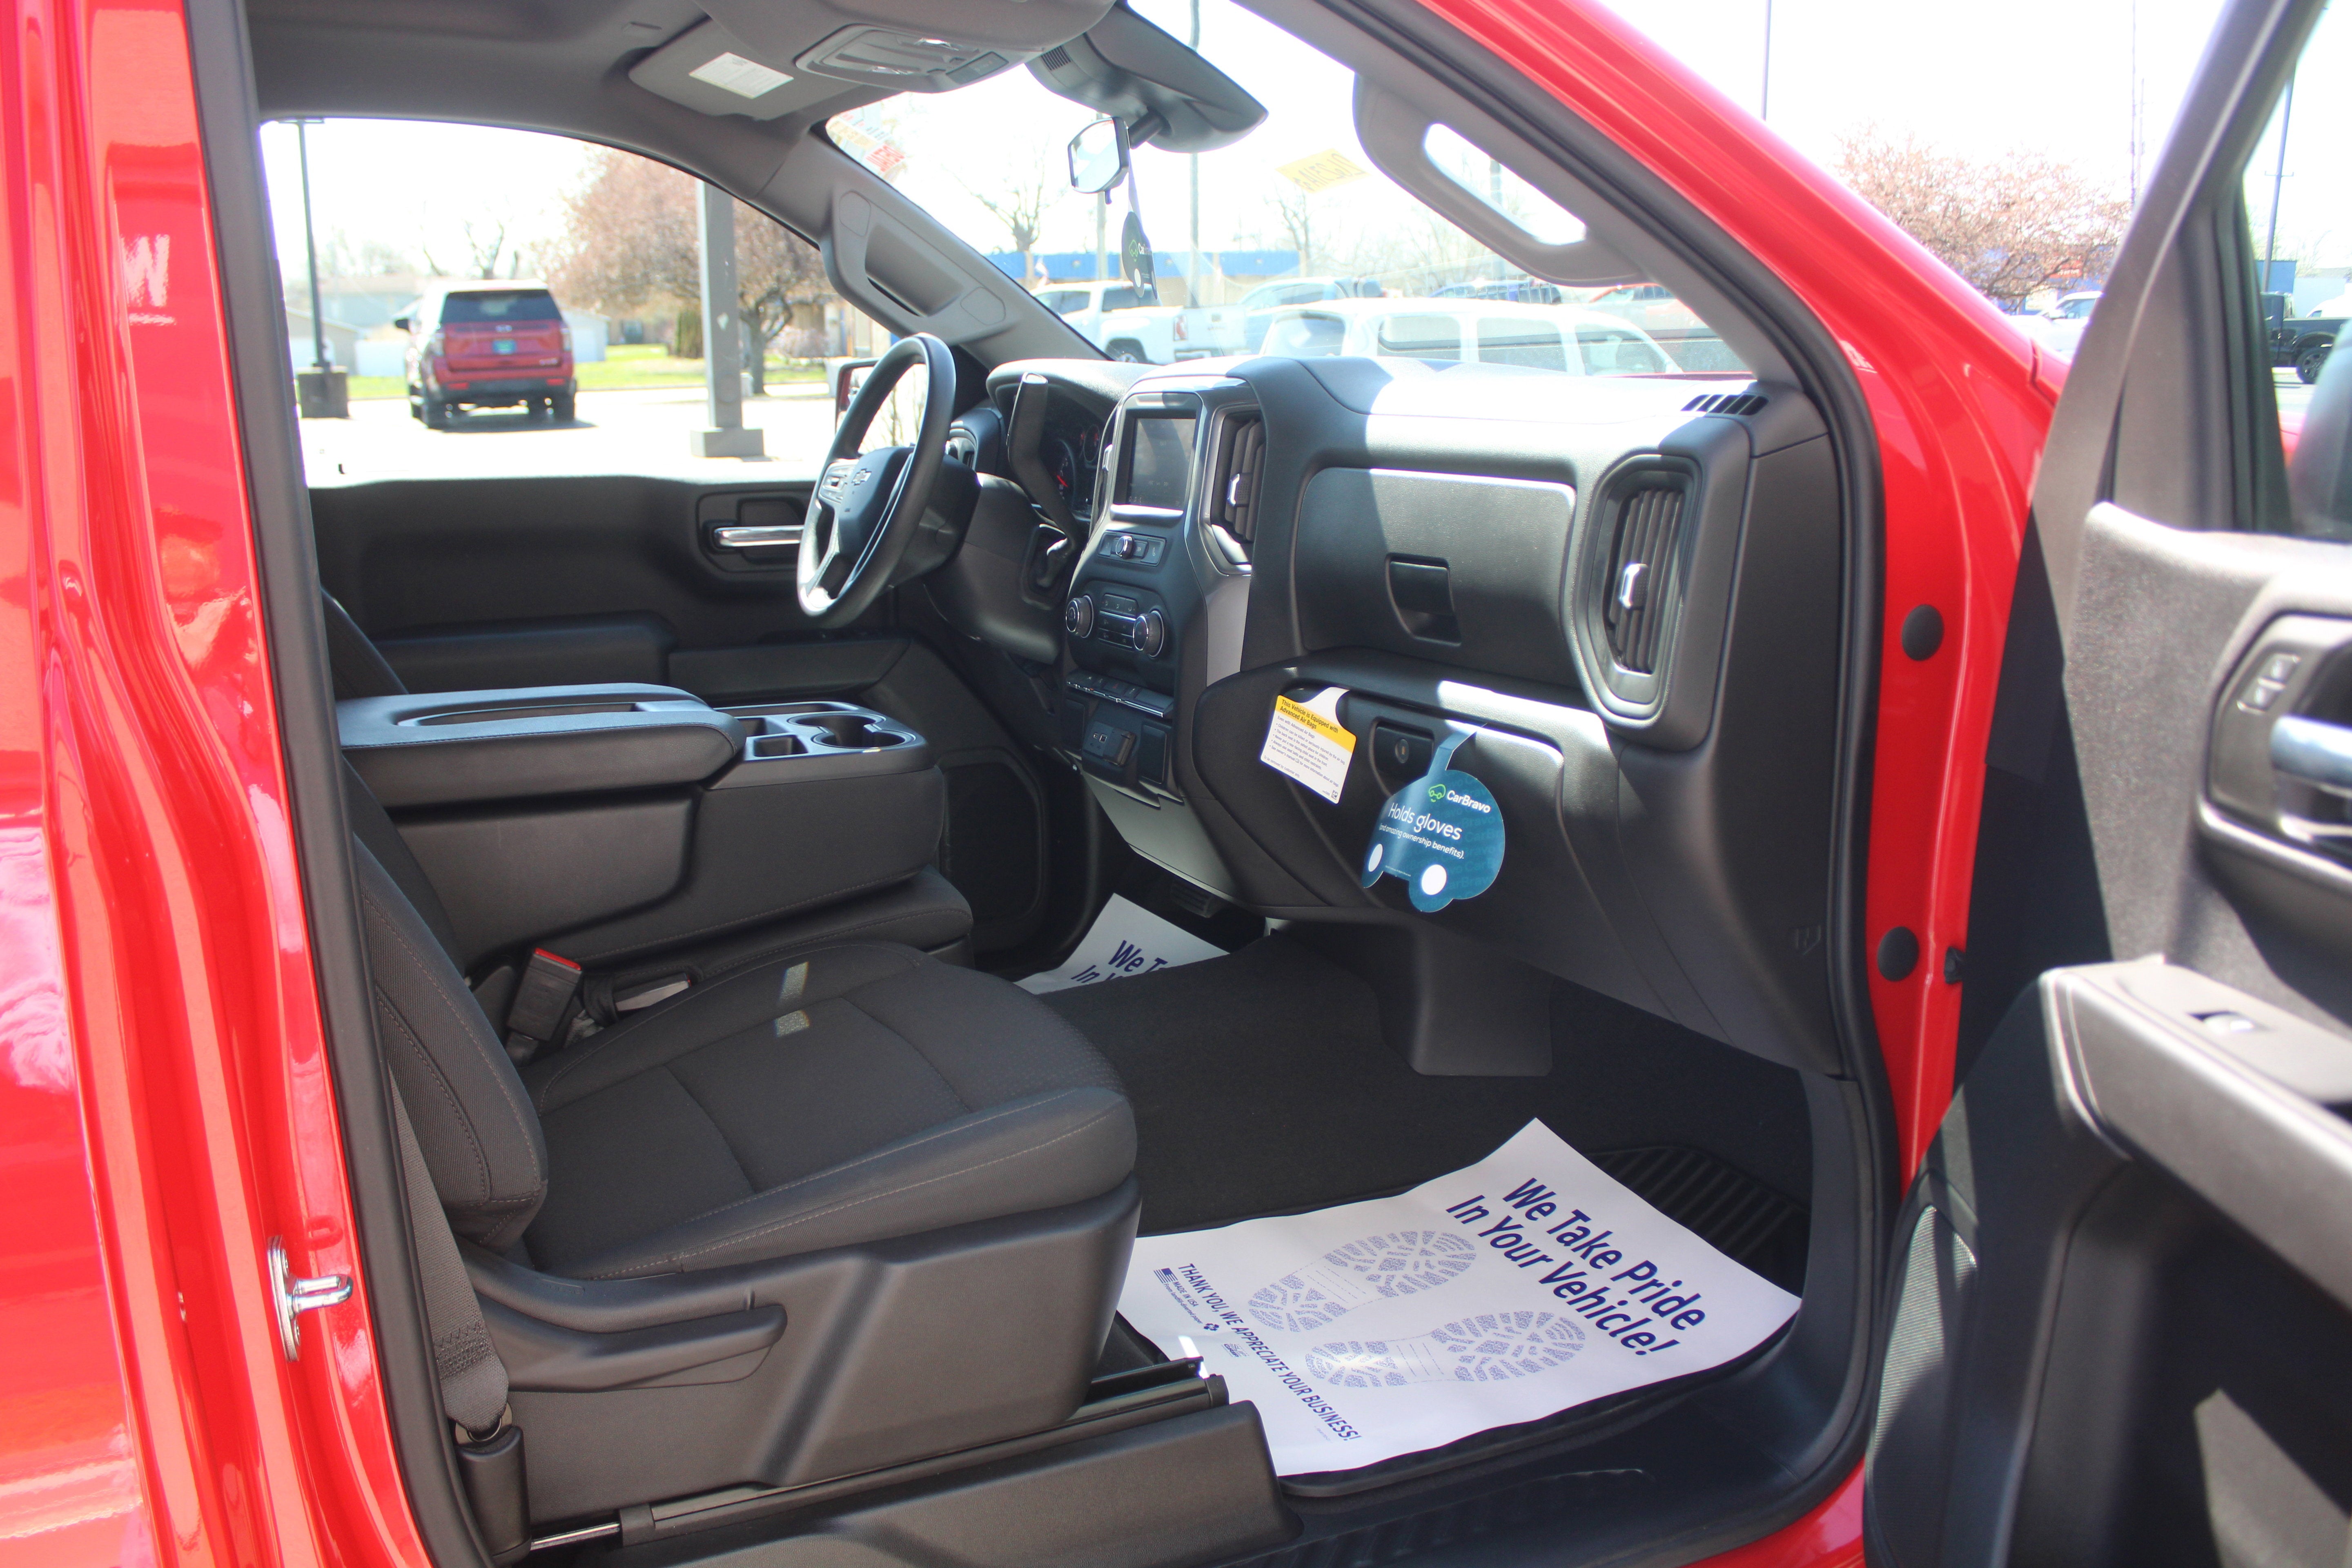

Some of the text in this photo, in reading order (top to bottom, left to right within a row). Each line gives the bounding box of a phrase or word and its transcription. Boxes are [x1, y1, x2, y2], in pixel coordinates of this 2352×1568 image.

[1280, 706, 1300, 719] Advanced
[1307, 719, 1316, 729] Bags
[1282, 699, 1290, 707] This
[1292, 704, 1305, 715] Vehicle
[1311, 715, 1329, 728] Equipped
[1291, 723, 1304, 732] Advanced
[1447, 790, 1491, 813] CarBravo
[1388, 802, 1463, 840] Holds gloves
[1386, 826, 1403, 839] amazing
[1403, 833, 1432, 848] ownership
[1432, 841, 1464, 860] benefits).
[1108, 940, 1144, 972] We
[1071, 965, 1100, 983] In
[1502, 1178, 1706, 1330] We Take Pride
[1164, 1283, 1173, 1292] From
[1172, 1281, 1187, 1294] MADE
[1178, 1263, 1214, 1293] THANK
[1446, 1195, 1681, 1356] In Your Vehicle!
[1202, 1292, 1229, 1312] YOU,
[1219, 1311, 1245, 1325] WE
[1231, 1327, 1290, 1372] APPRECIATE
[1278, 1371, 1313, 1396] YOUR
[1301, 1394, 1363, 1441] BUSINESS!
